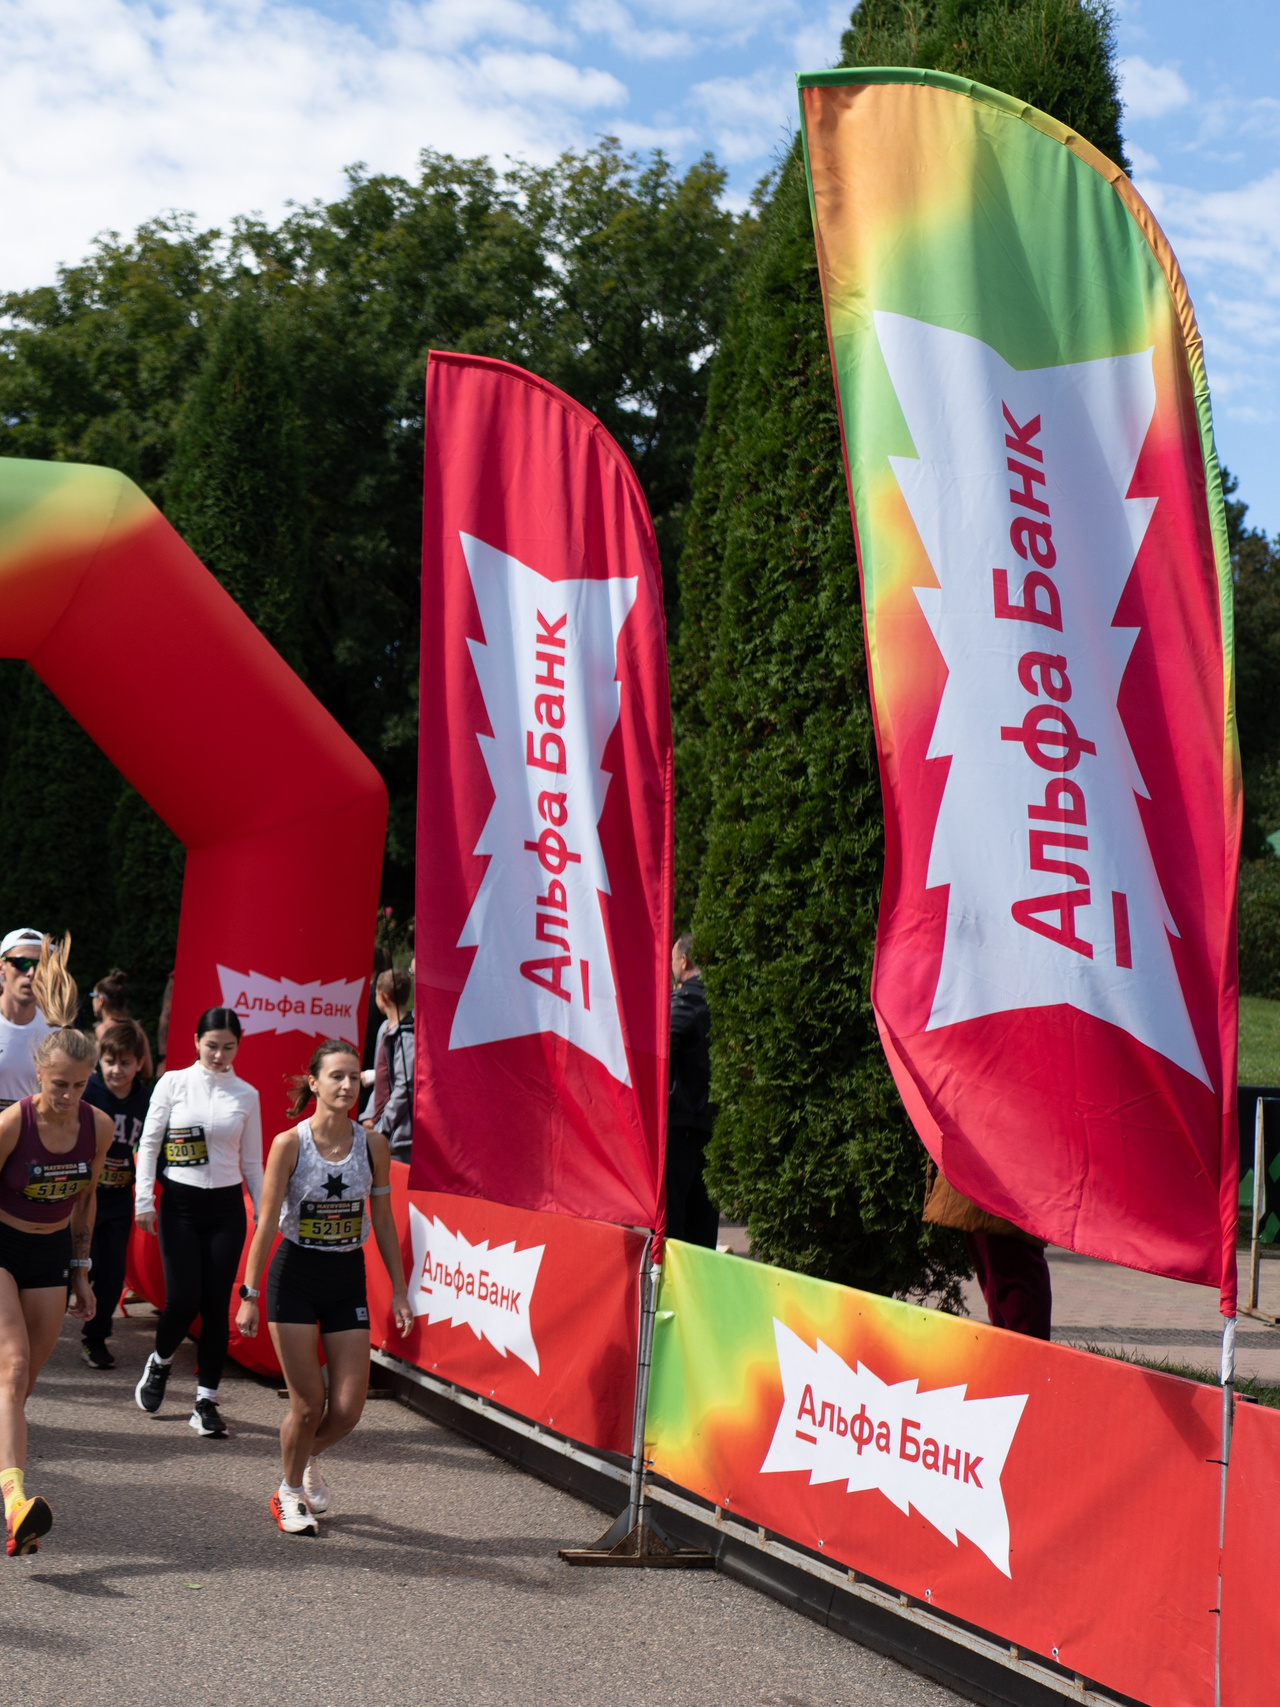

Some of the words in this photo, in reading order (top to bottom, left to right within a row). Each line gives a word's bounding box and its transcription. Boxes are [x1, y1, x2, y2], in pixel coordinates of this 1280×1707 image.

[992, 400, 1063, 633] Банк
[526, 608, 568, 775] Банк
[1001, 652, 1097, 960] Альфа
[519, 791, 582, 1005] Альфа
[234, 991, 305, 1018] Альфа
[309, 997, 352, 1018] Банк
[37, 1183, 79, 1196] 5144
[168, 1145, 197, 1157] 5201
[312, 1221, 353, 1235] 5216
[421, 1250, 475, 1299] Альфа
[477, 1269, 522, 1315] Банк
[796, 1384, 891, 1456] Альфа
[899, 1417, 984, 1489] Банк
